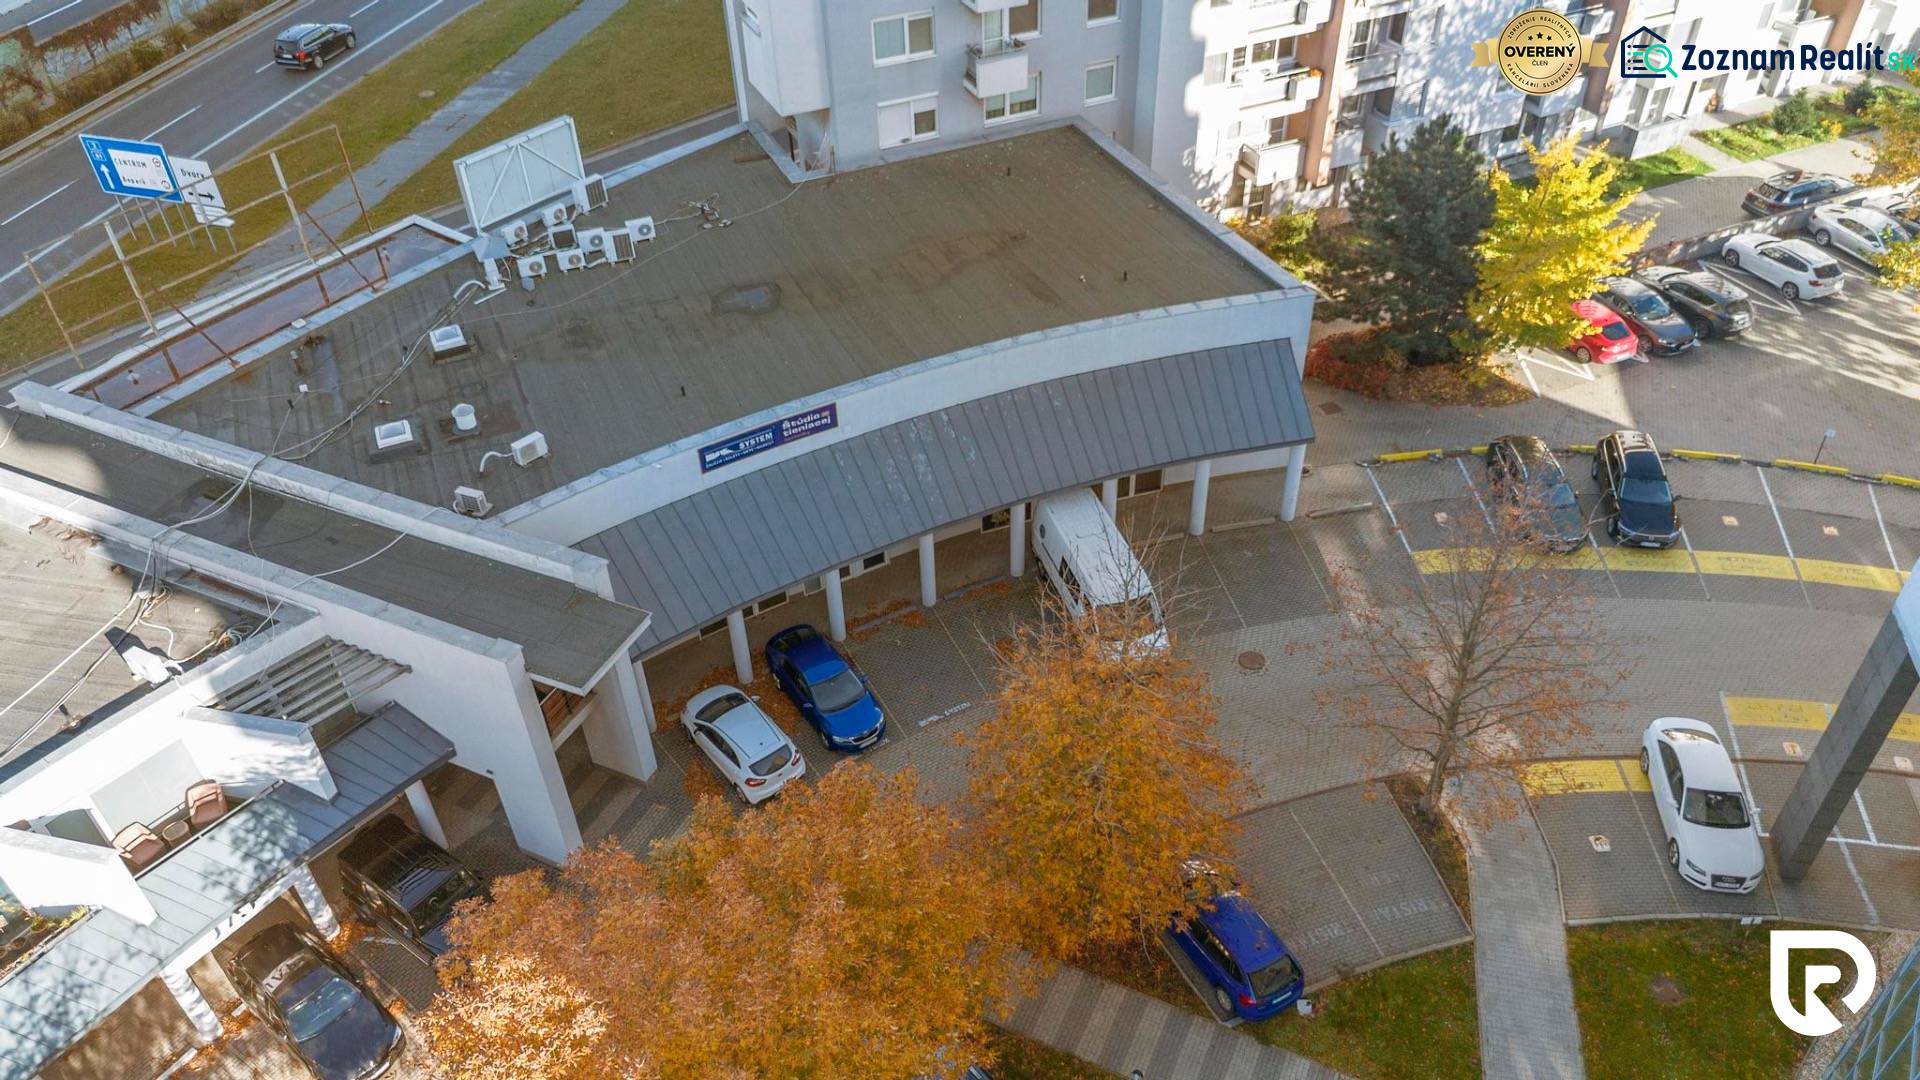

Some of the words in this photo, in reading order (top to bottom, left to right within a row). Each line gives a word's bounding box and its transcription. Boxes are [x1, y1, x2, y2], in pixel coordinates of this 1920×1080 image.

[114, 157, 147, 168] CENTRUM
[180, 168, 205, 179] Dvory
[739, 432, 773, 449] SYSTEM
